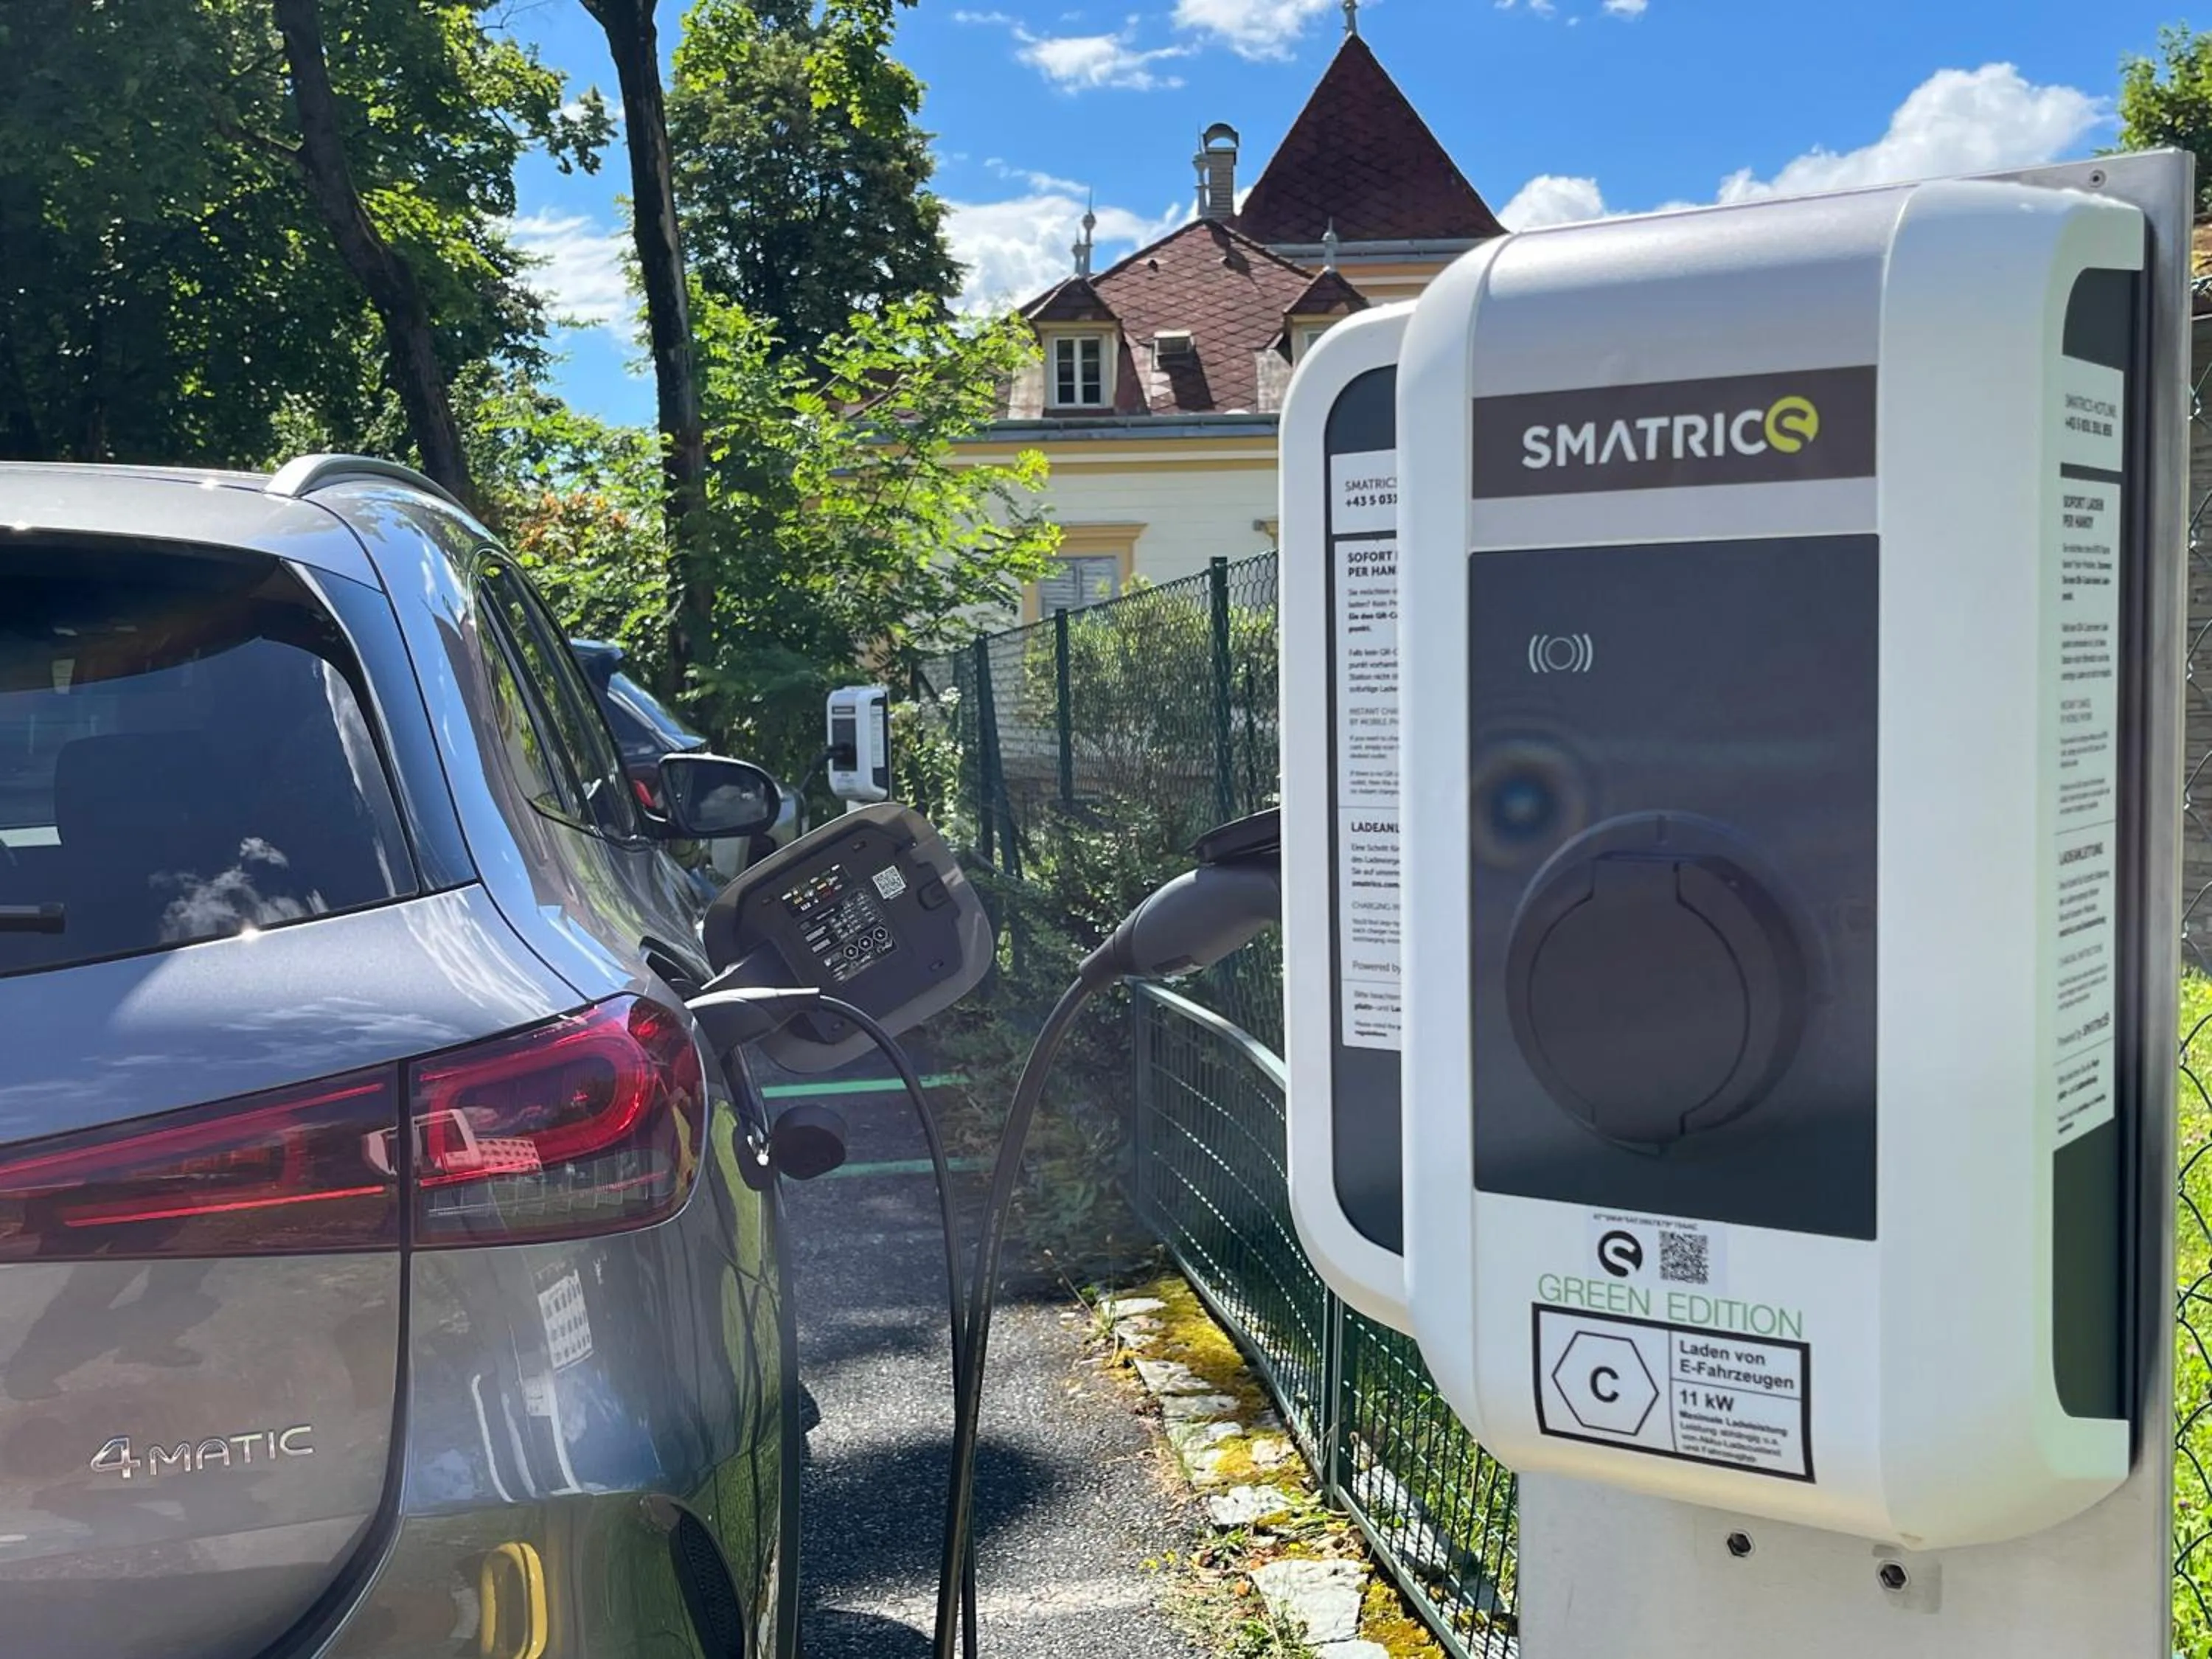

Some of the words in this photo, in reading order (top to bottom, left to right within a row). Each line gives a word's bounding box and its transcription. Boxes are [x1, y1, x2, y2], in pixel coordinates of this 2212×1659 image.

[1345, 495, 1366, 507] +43
[1369, 495, 1376, 505] 5
[1347, 551, 1392, 563] SOFORT
[1348, 566, 1368, 577] PER
[1352, 960, 1390, 972] Powered
[1537, 1273, 1650, 1316] GREEN
[1667, 1292, 1803, 1338] EDITION
[1680, 1340, 1730, 1361] Laden
[1733, 1350, 1766, 1366] von
[1590, 1366, 1619, 1402] C
[1680, 1360, 1795, 1390] E-Fahrzeugen
[1680, 1390, 1697, 1406] 11
[1705, 1393, 1734, 1412] kW
[90, 1426, 313, 1478] 4MATIC
